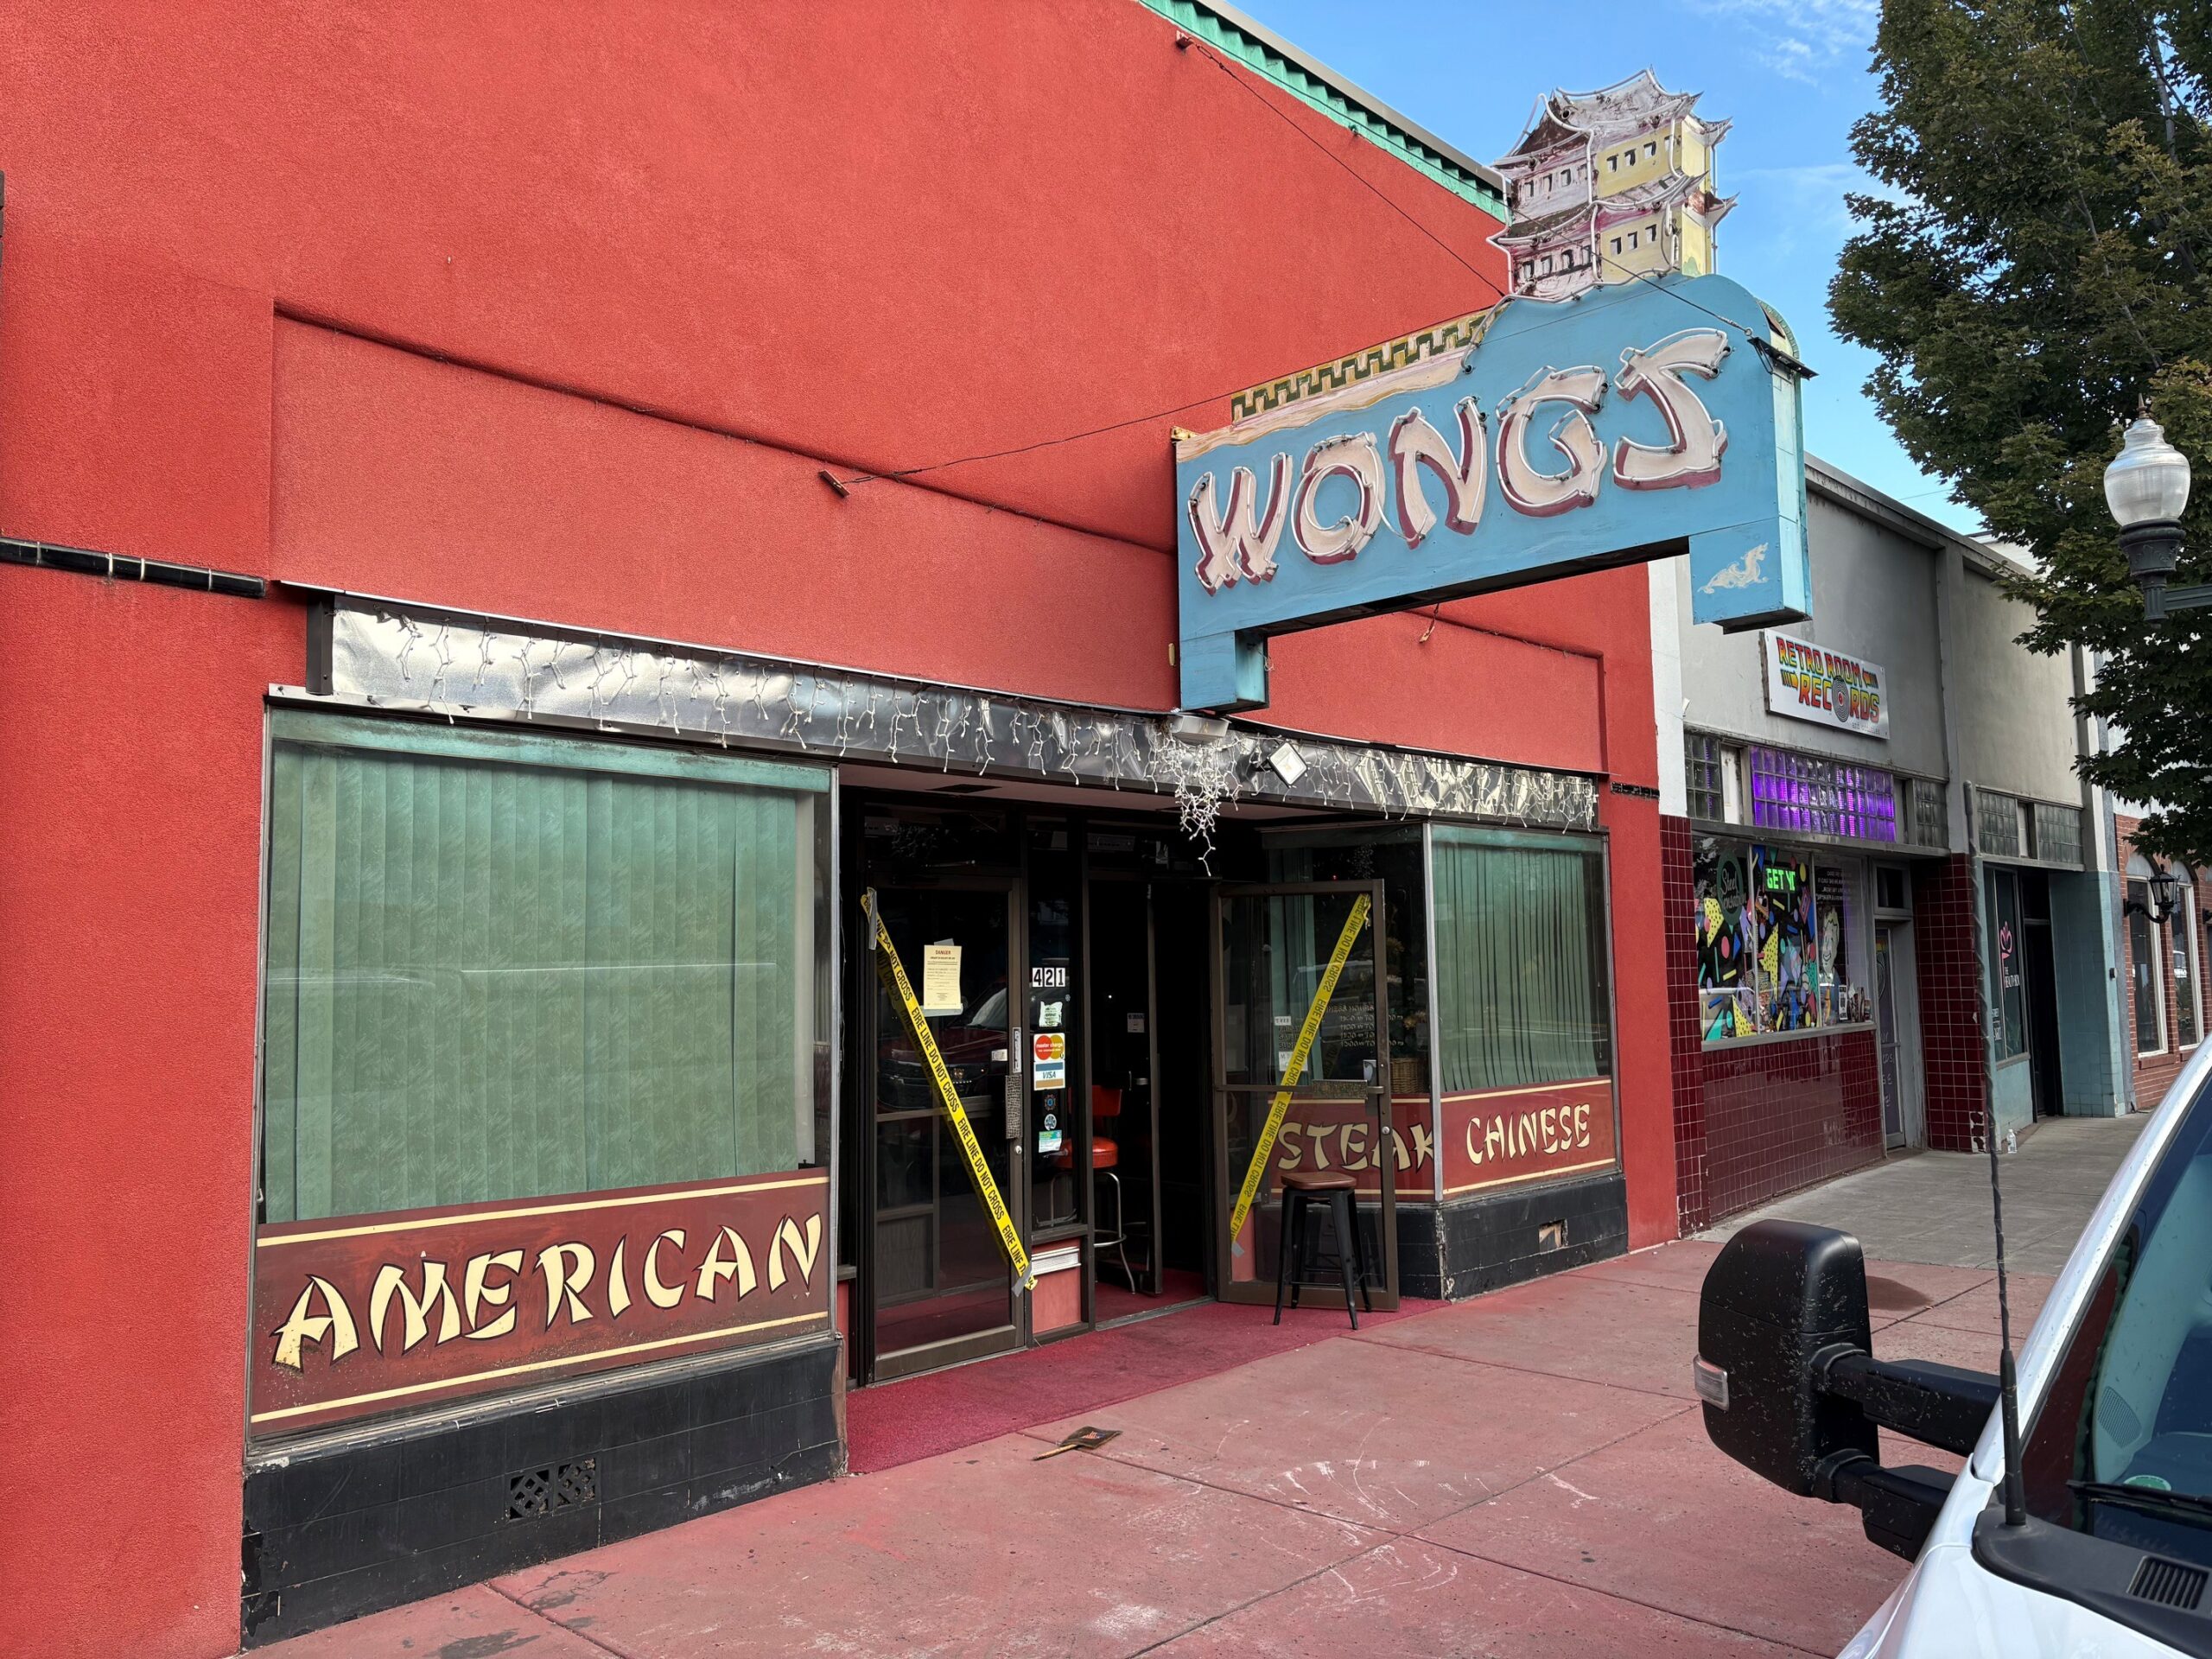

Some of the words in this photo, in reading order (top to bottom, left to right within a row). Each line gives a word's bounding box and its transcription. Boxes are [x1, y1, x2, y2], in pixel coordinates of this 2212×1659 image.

[1776, 635, 1824, 677] RETRO
[1824, 652, 1863, 688] ROOM
[1798, 671, 1880, 724] RECORDS
[1765, 868, 1784, 890] GET
[896, 969, 913, 1001] CROSS
[1033, 969, 1064, 986] 421
[920, 1027, 934, 1051] LINE
[929, 1050, 939, 1064] DO
[935, 1065, 947, 1083] NOT
[943, 1082, 960, 1113] CROSS
[1465, 1102, 1591, 1166] CHINESE
[966, 1136, 980, 1160] LINE
[975, 1157, 985, 1173] DO
[980, 1171, 994, 1192] NOT
[988, 1189, 1005, 1221] CROSS
[270, 1211, 823, 1373] AMERICAN
